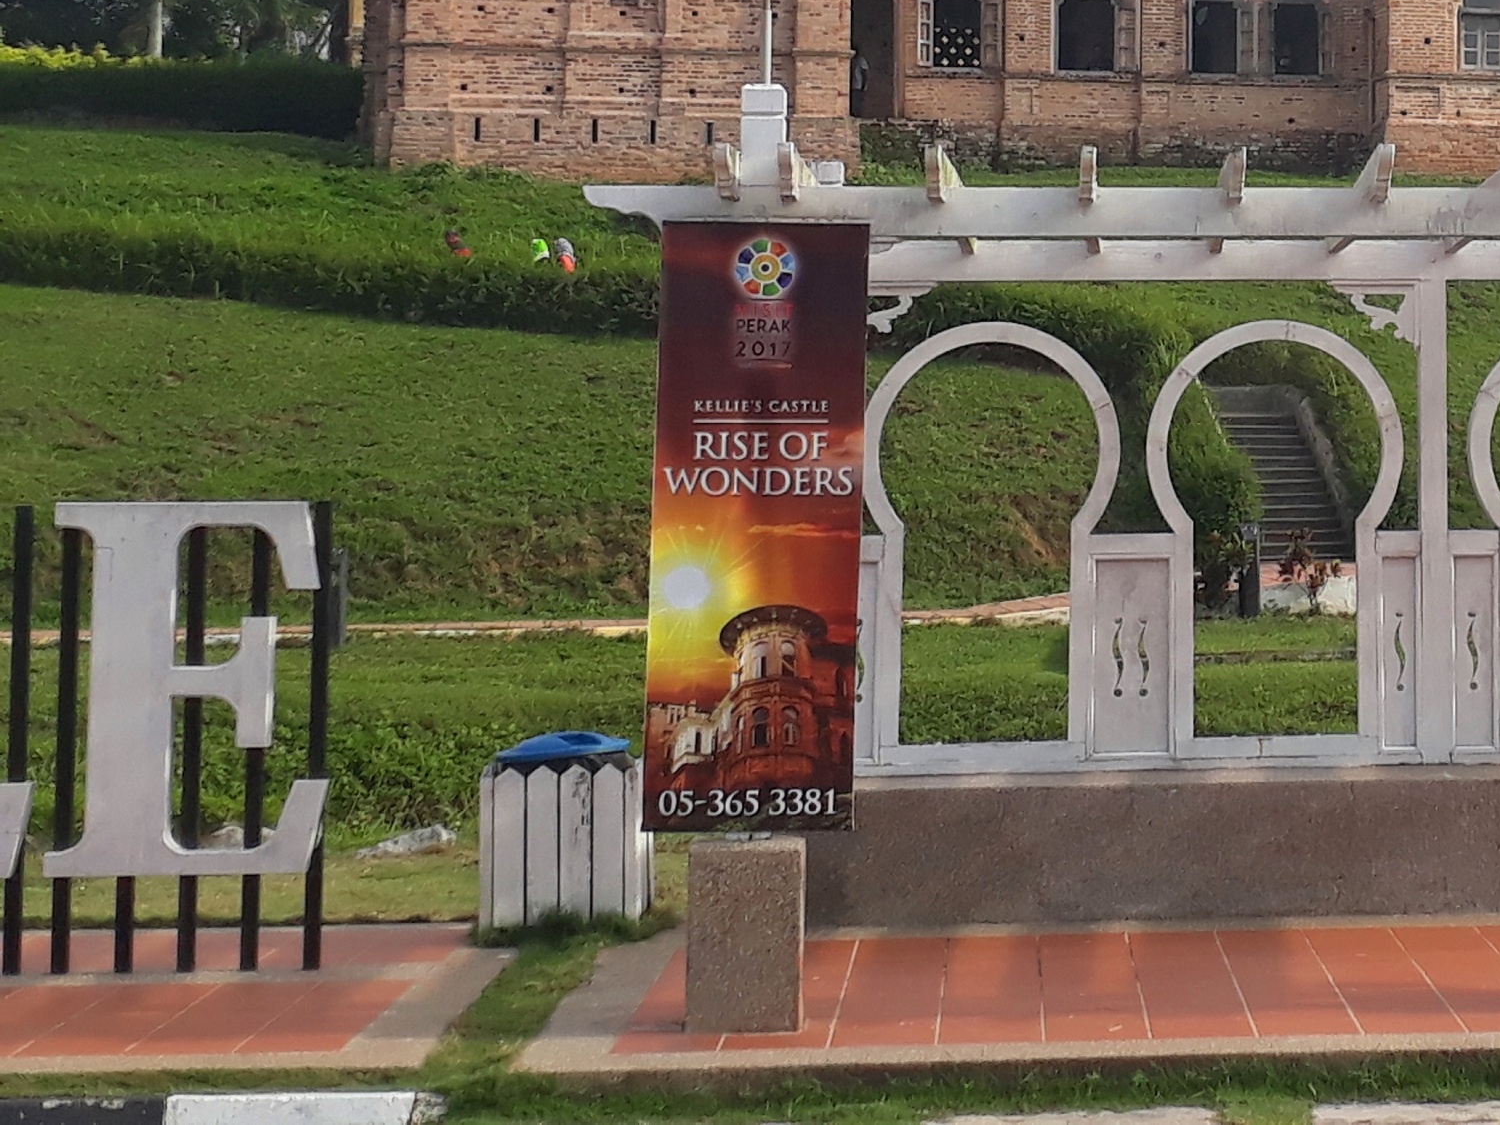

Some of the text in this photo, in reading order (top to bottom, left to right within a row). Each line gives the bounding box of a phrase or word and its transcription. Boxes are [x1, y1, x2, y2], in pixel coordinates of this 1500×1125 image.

[736, 318, 791, 333] PERAK
[735, 340, 792, 357] 2017
[693, 400, 830, 414] KELLIE'S CASTLE
[693, 431, 830, 461] RISE OF
[663, 466, 854, 497] WONDERS
[658, 787, 837, 817] 05-365 3381
